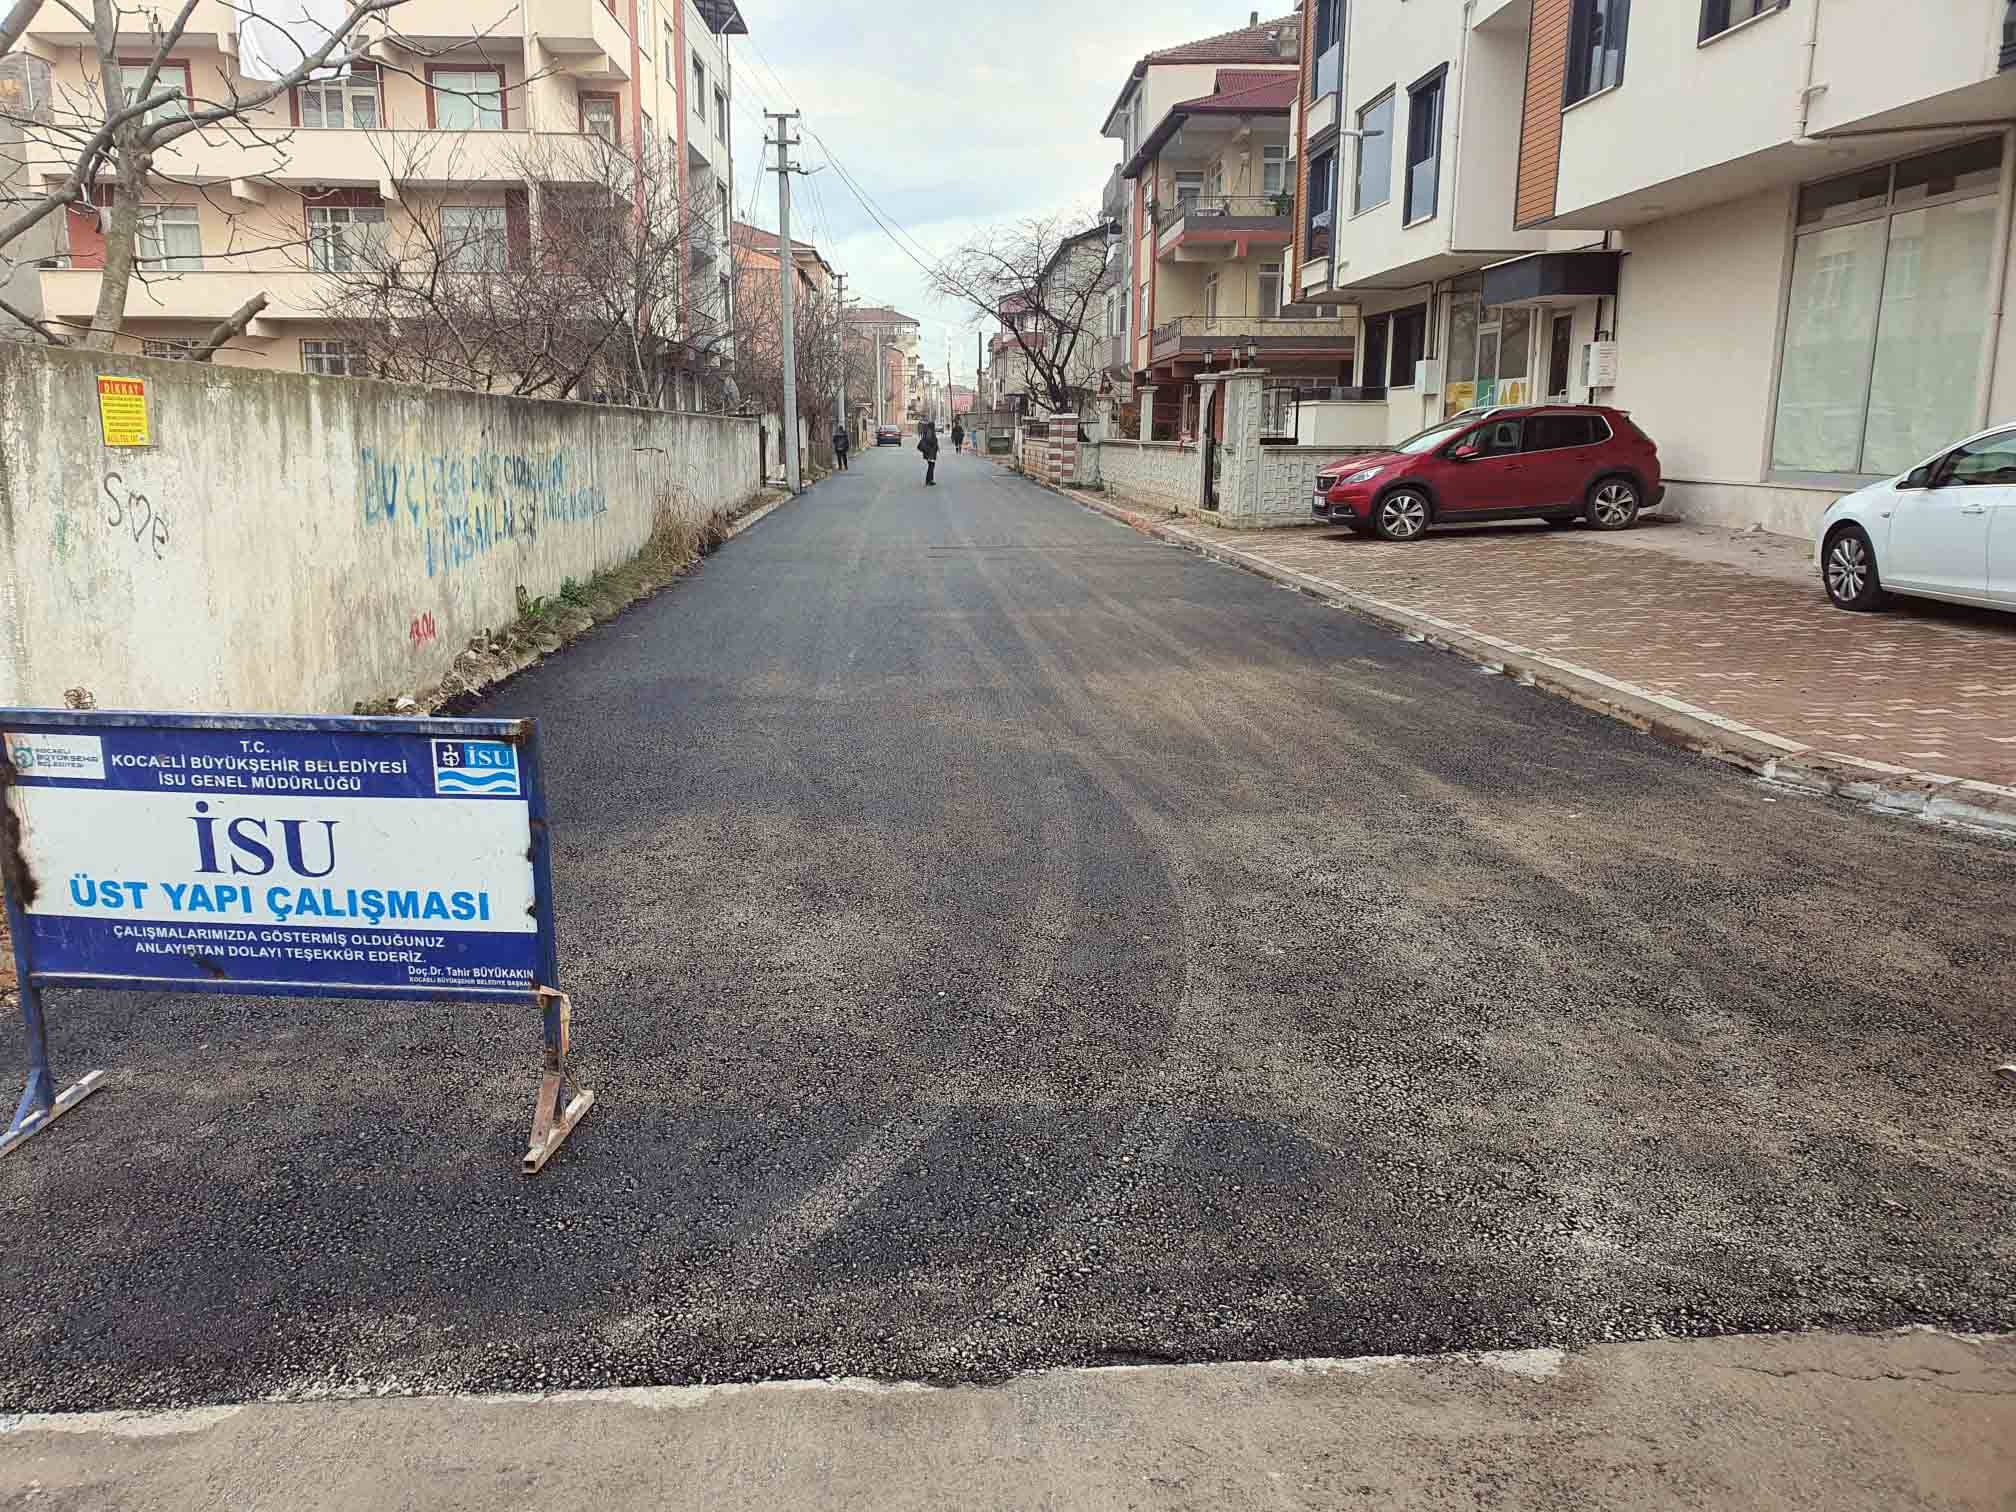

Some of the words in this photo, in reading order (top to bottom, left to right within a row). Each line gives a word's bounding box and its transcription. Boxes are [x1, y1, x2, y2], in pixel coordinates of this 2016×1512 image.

[240, 740, 270, 753] T.C.
[465, 745, 513, 767] İSU
[111, 754, 186, 769] KOCAELİ
[190, 755, 300, 774] BÜYÜKŞEHİR
[304, 758, 408, 774] BELEDİYESİ
[158, 771, 186, 786] İSU
[190, 774, 248, 788] GENEL
[251, 774, 362, 791] MÜDÜRLÜĞÜ
[186, 800, 342, 878] İSU
[69, 873, 149, 910] ÜST
[159, 882, 253, 913] YAPI
[266, 886, 490, 925] ÇALIŞMASI
[113, 925, 258, 941] ÇALIŞMALARIMIZDA
[260, 930, 347, 947] GÖSTERMİŞ
[351, 933, 446, 949] OLDUĞUNUZ
[135, 942, 225, 957] ANLAYIŞTAN
[228, 945, 282, 959] DOLAYI
[286, 947, 365, 963] TEŞEKKÜR
[368, 949, 428, 964] EDERİZ.
[446, 966, 471, 978] Tahir
[472, 966, 534, 980] BÜYÜKAKIN
